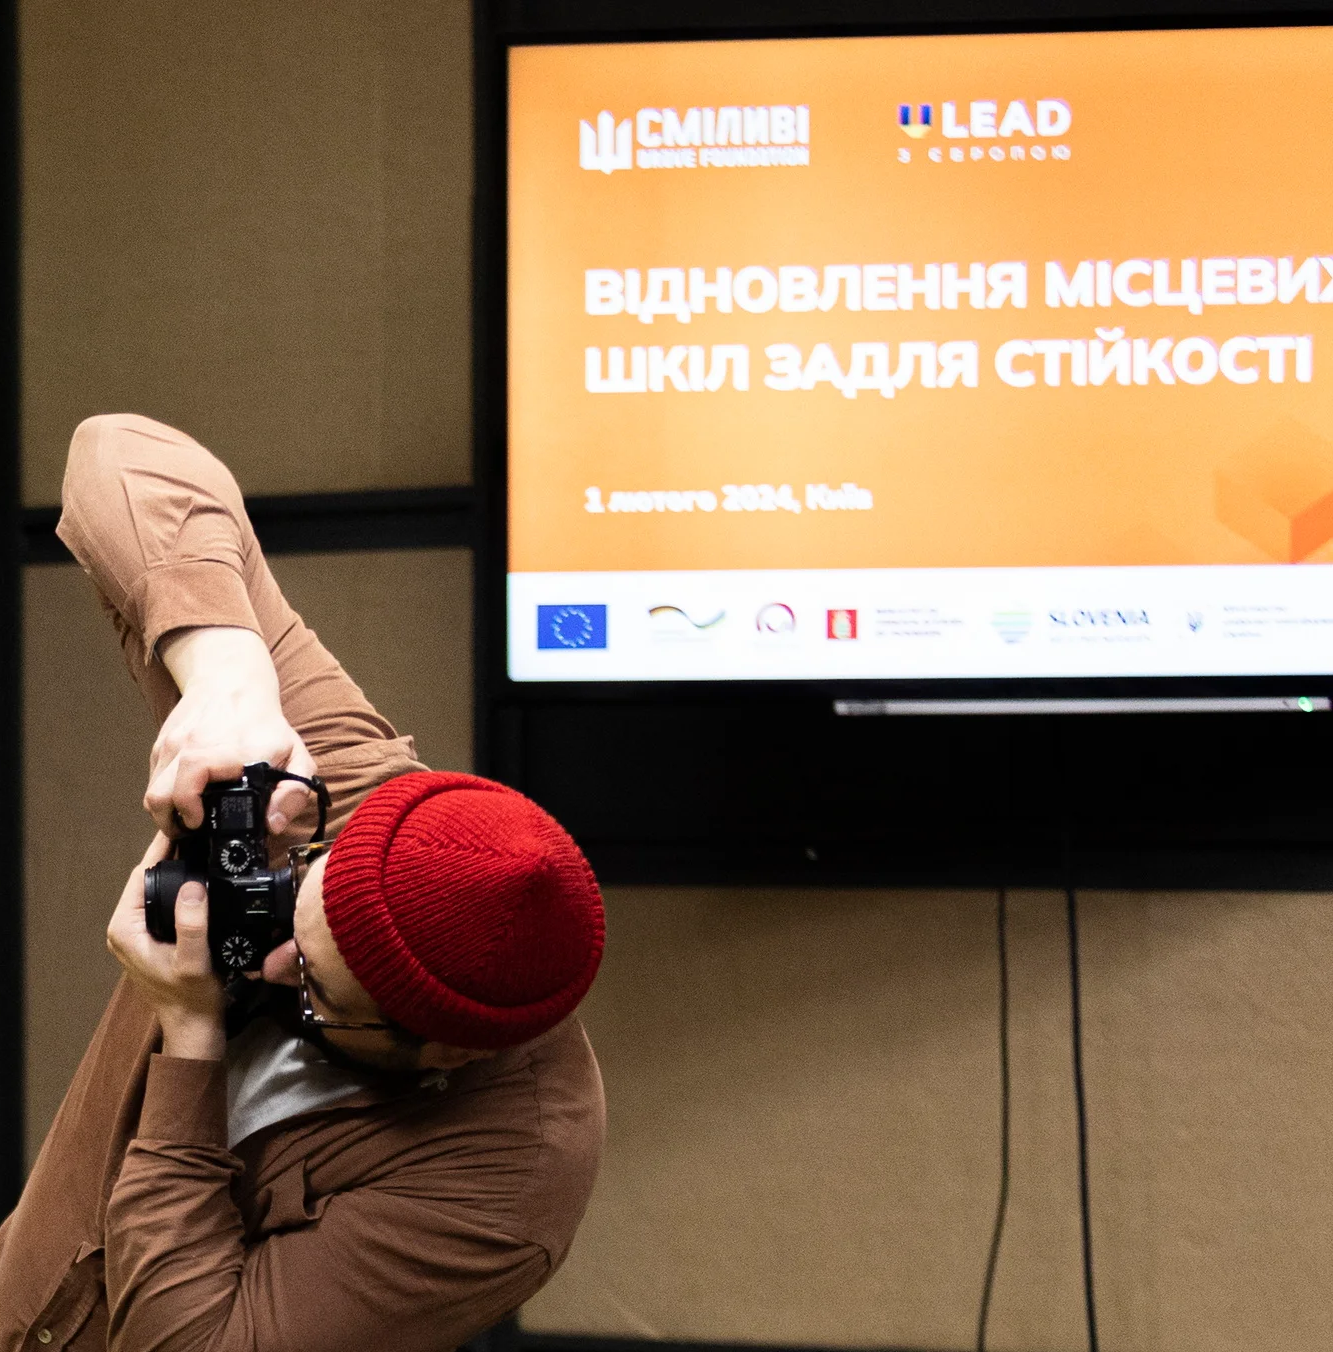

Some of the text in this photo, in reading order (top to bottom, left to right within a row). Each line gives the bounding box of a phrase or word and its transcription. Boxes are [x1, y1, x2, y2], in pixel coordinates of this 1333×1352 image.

[636, 104, 809, 147] СМІЛИВІ
[941, 99, 1072, 138] LEAD
[585, 261, 1028, 324] ВІДНОВЛЕННЯ
[585, 326, 1313, 399] ШКІЛ ЗАДЛЯ СТІЙКОСТІ
[584, 482, 874, 514] 1 лютого 2024, Київ
